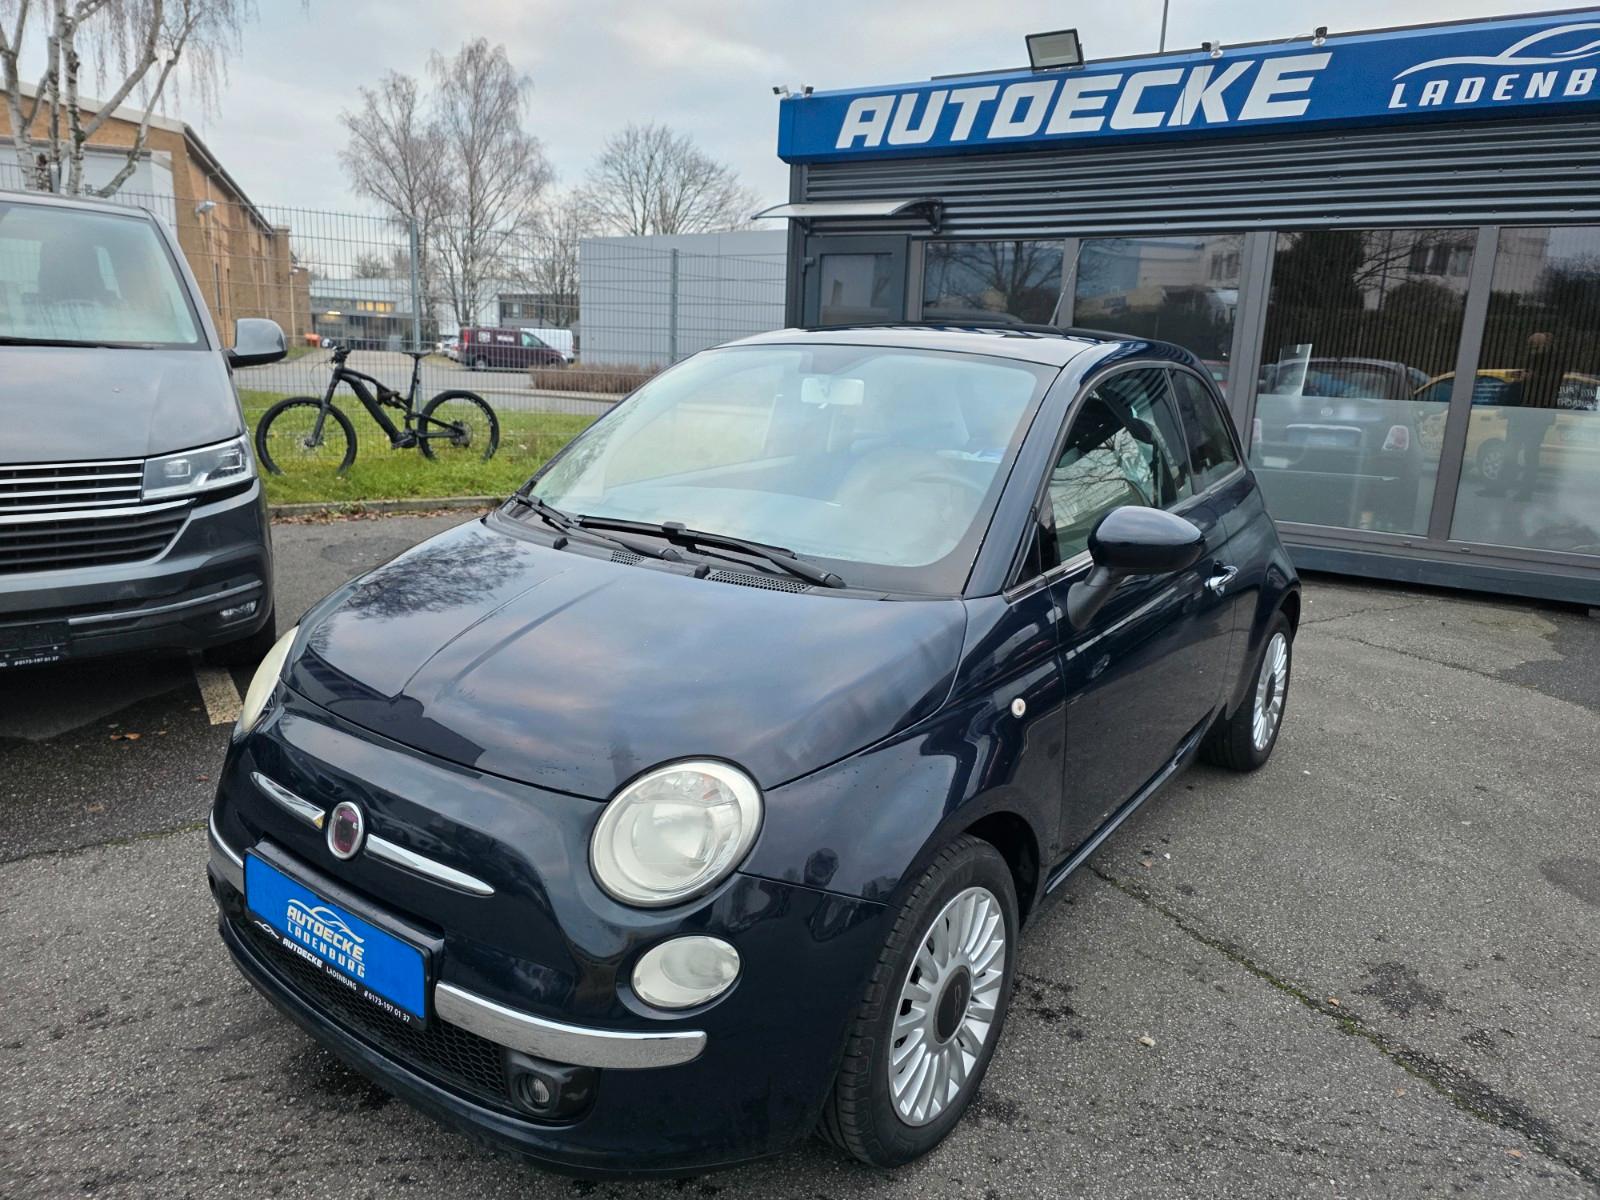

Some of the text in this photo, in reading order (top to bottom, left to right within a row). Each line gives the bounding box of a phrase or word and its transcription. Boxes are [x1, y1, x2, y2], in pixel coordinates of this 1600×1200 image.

[835, 52, 1333, 149] AUTOECKE
[1388, 68, 1597, 109] LADENB
[287, 905, 365, 962] AUTOECKE
[287, 920, 366, 979] LADENBURG
[282, 937, 323, 968] AUTOECKE
[326, 965, 357, 991] LADENBURG
[402, 1012, 410, 1023] 37
